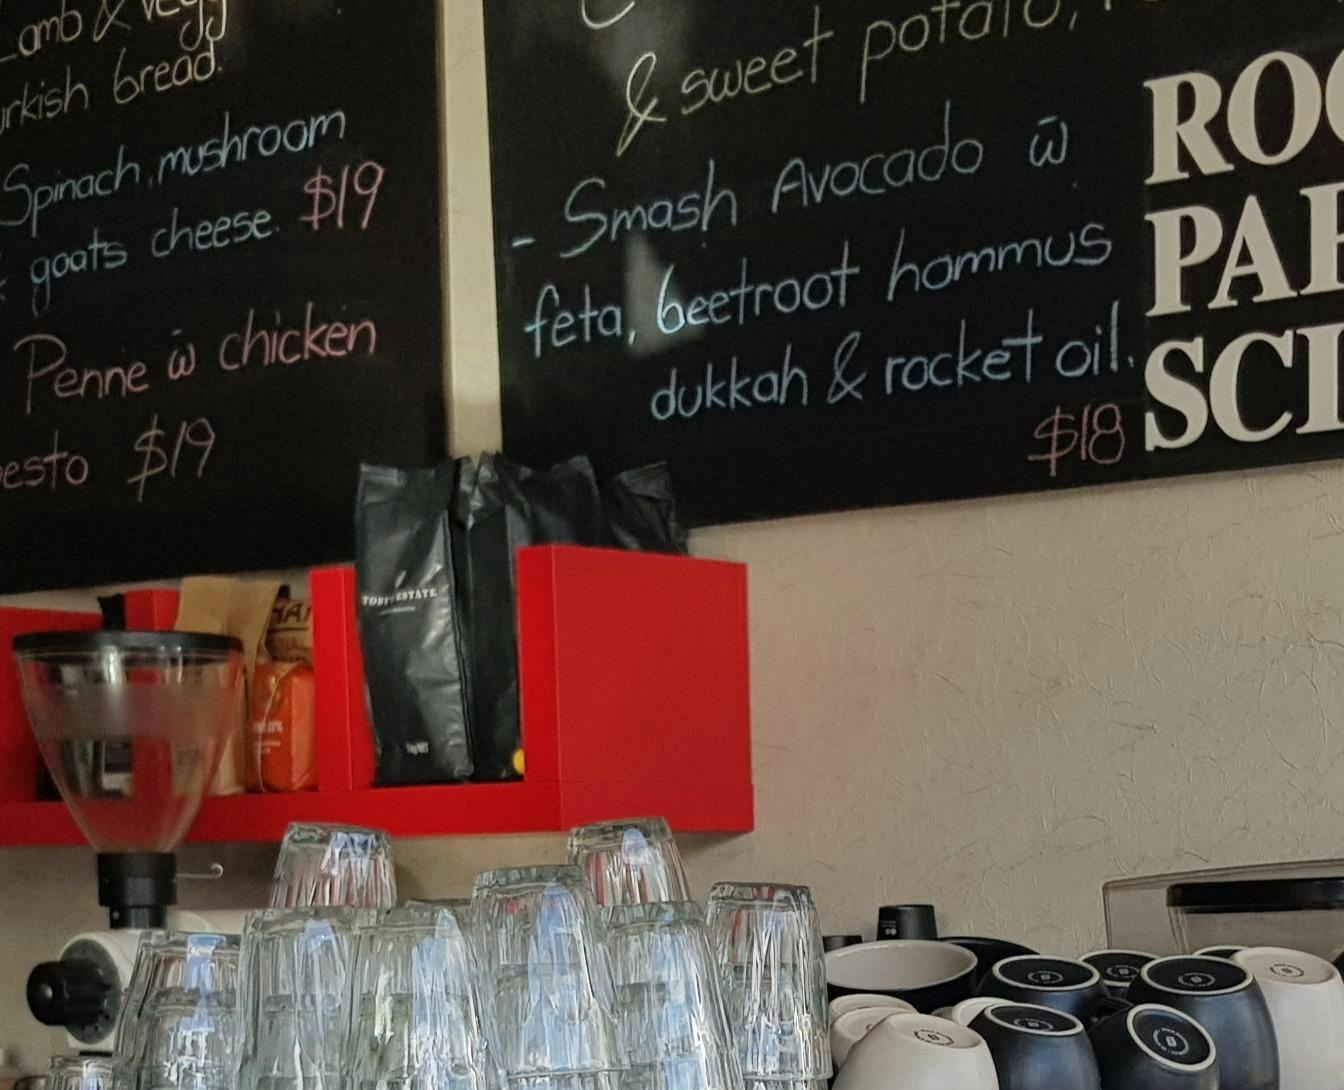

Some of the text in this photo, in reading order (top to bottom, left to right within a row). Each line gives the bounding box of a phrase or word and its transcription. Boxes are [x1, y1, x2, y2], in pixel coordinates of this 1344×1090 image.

[615, 52, 667, 157] &
[681, 4, 834, 116] sweet
[158, 108, 347, 184] mushroom
[559, 158, 738, 258] Smash
[771, 100, 985, 214] Avocado
[29, 227, 128, 317] goats
[299, 160, 386, 231] $19
[524, 283, 637, 359] feta,
[656, 238, 861, 336] beetroot
[14, 333, 150, 415] Penne
[219, 301, 376, 370] chicken
[651, 344, 809, 421] dukkah
[825, 330, 867, 406] &
[884, 307, 1044, 397] rocket
[127, 413, 217, 502] $19
[1026, 402, 1126, 477] $18
